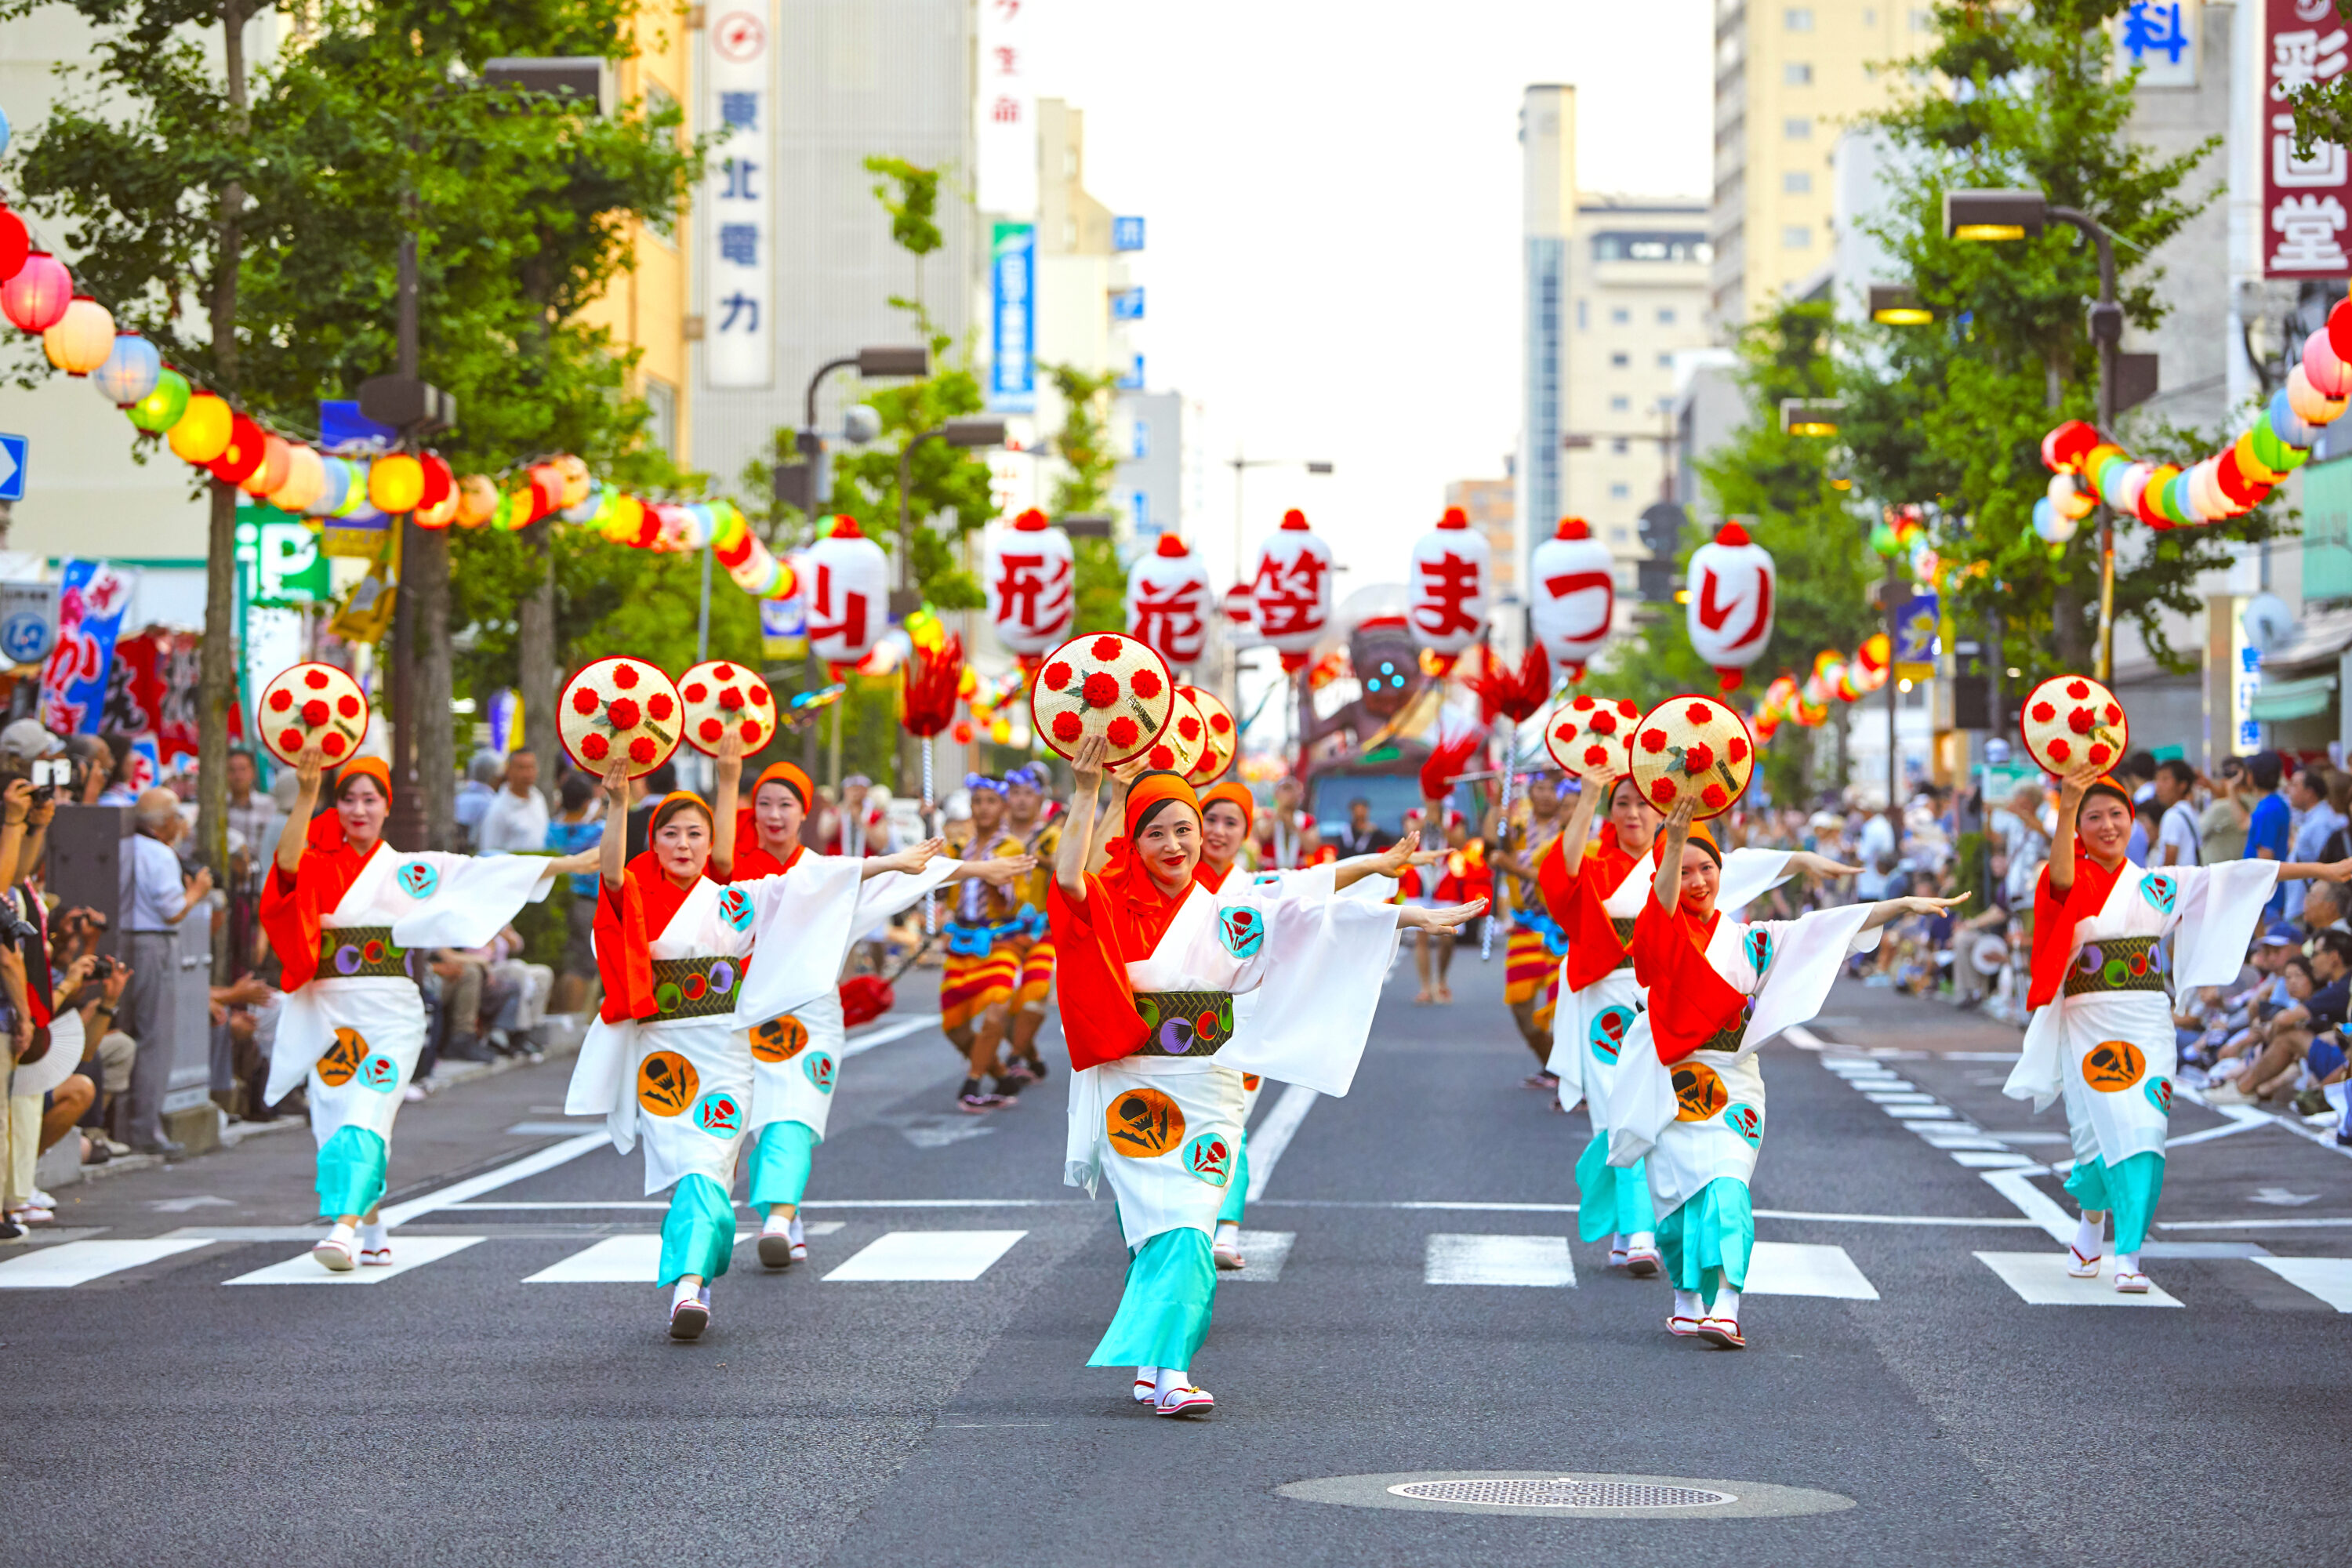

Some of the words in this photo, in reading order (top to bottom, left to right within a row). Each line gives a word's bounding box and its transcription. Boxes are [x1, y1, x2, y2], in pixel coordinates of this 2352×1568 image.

[2124, 1, 2188, 64] 科
[719, 91, 759, 332] 東北電力
